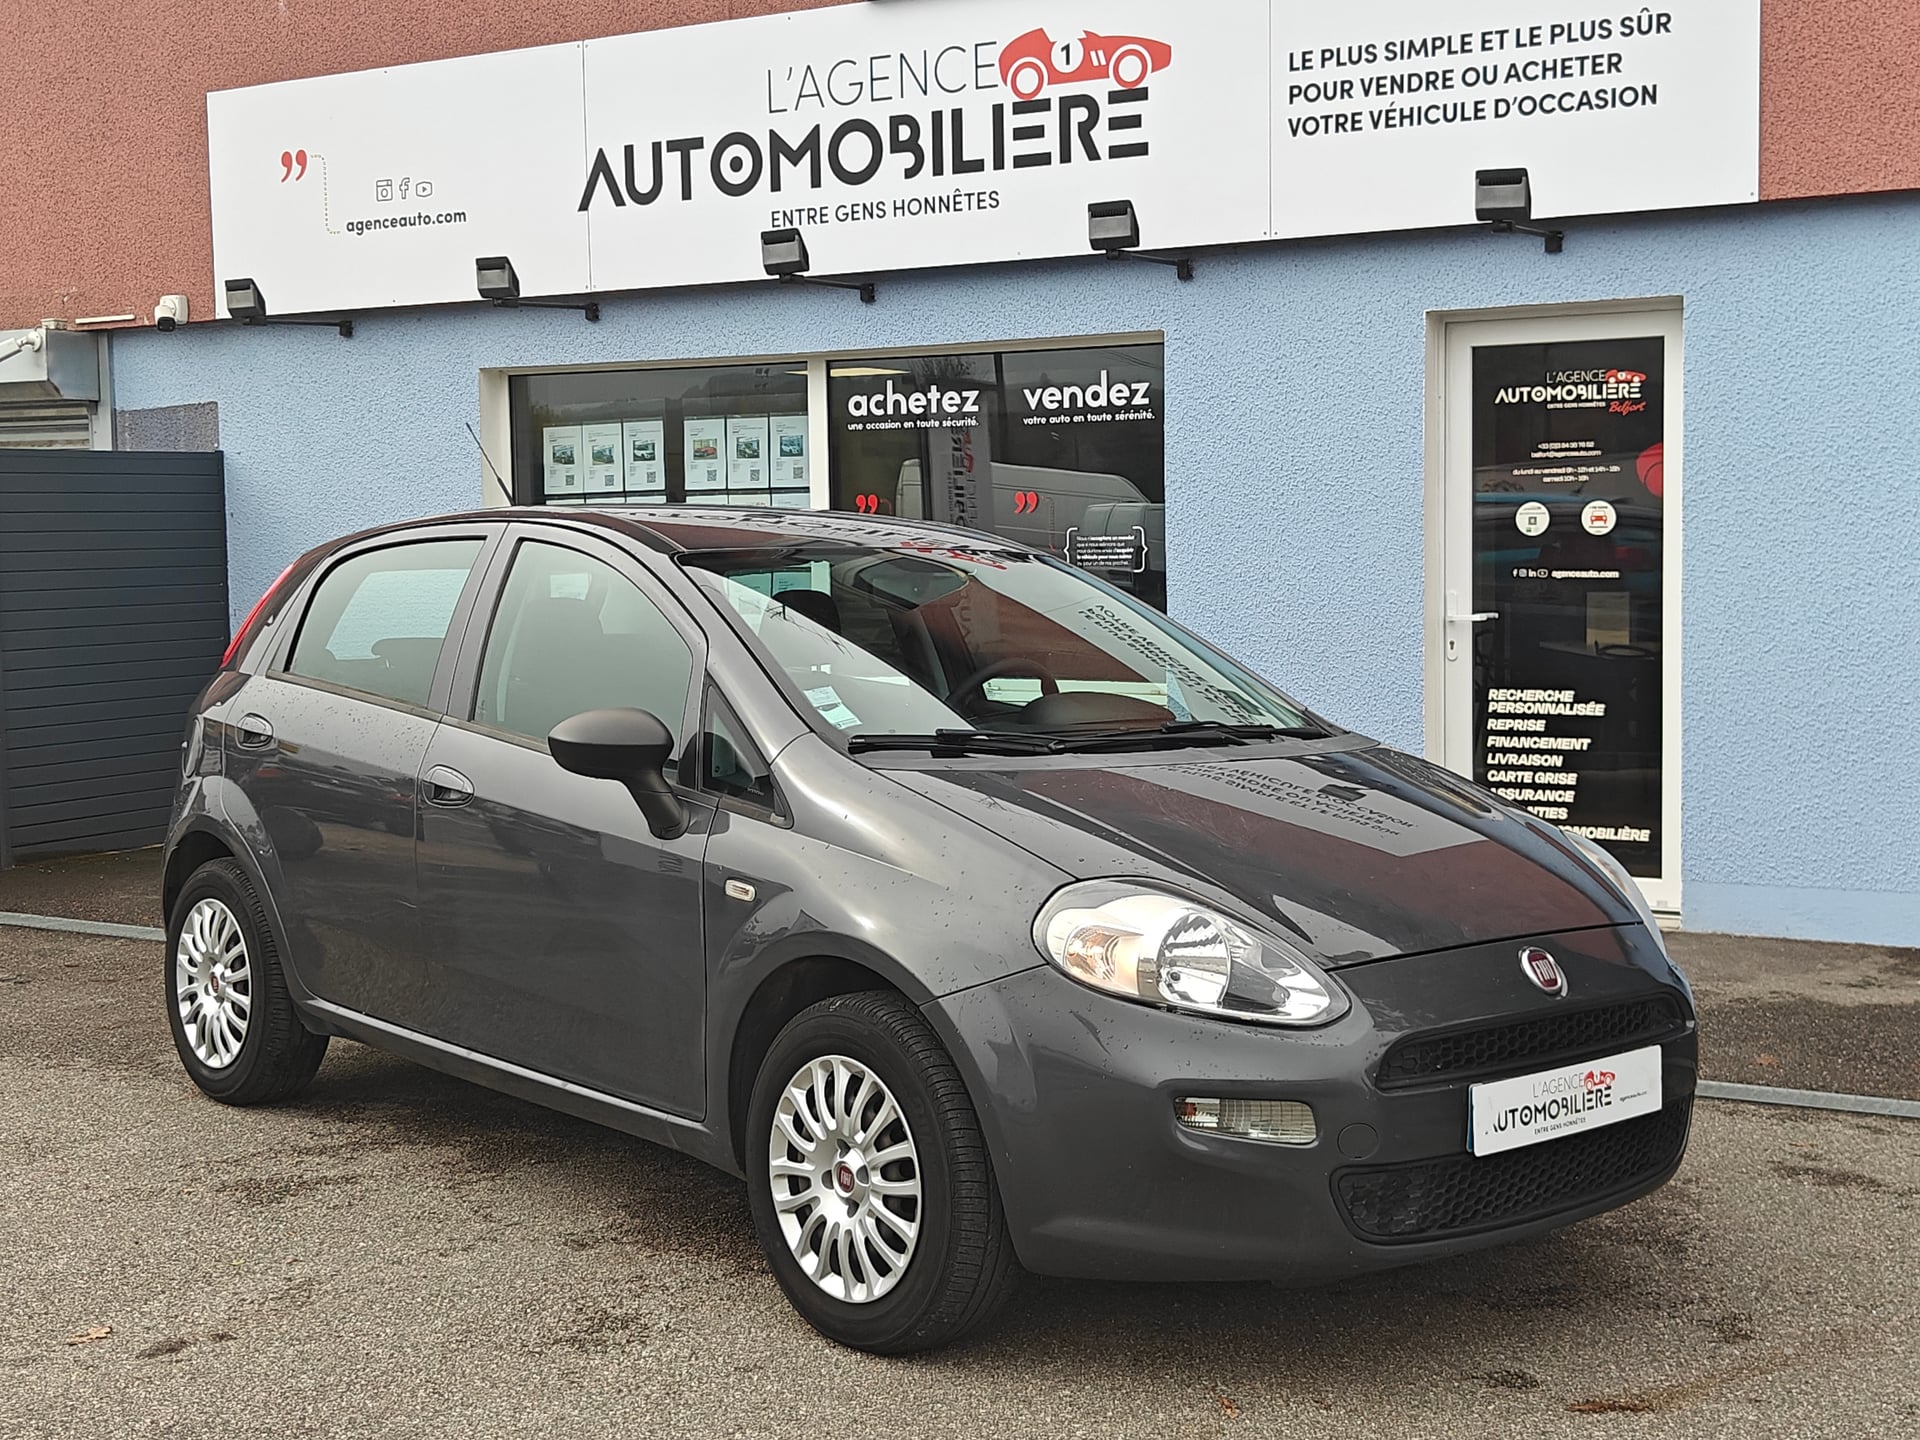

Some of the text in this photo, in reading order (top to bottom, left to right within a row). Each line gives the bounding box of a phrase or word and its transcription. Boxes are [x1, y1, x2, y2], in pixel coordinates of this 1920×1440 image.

[1289, 7, 1672, 72] LE PLUS SIMPLE ET LE PLUS SÛR
[767, 41, 999, 114] L'AGENCE
[1289, 52, 1622, 105] POUR VENDRE OU ACHETER
[1288, 84, 1657, 138] VOTRE VÉHICULE D'OCCASION
[771, 188, 1000, 228] ENTRE GENS HONNÊTES
[346, 209, 467, 236] agenceauto.com
[1546, 369, 1606, 384] L'AGENCE
[1023, 369, 1150, 411] vendez
[848, 380, 980, 417] achetez
[1608, 400, 1646, 416] Belfort
[848, 415, 979, 431] une occasion en toute sécurité.
[1023, 408, 1156, 425] votre auto en toute sérénité.
[1488, 688, 1575, 703] RECHERCHE
[1488, 701, 1606, 717] PERSONNALISÉE
[1487, 719, 1546, 732] REPRISE
[1487, 735, 1592, 751] FINANCEMENT
[1487, 753, 1564, 768] LIVRAISON
[1487, 770, 1578, 786] CARTE GRISE
[1532, 1072, 1585, 1098] L'AGENCE
[1534, 1125, 1549, 1135] ENTRE
